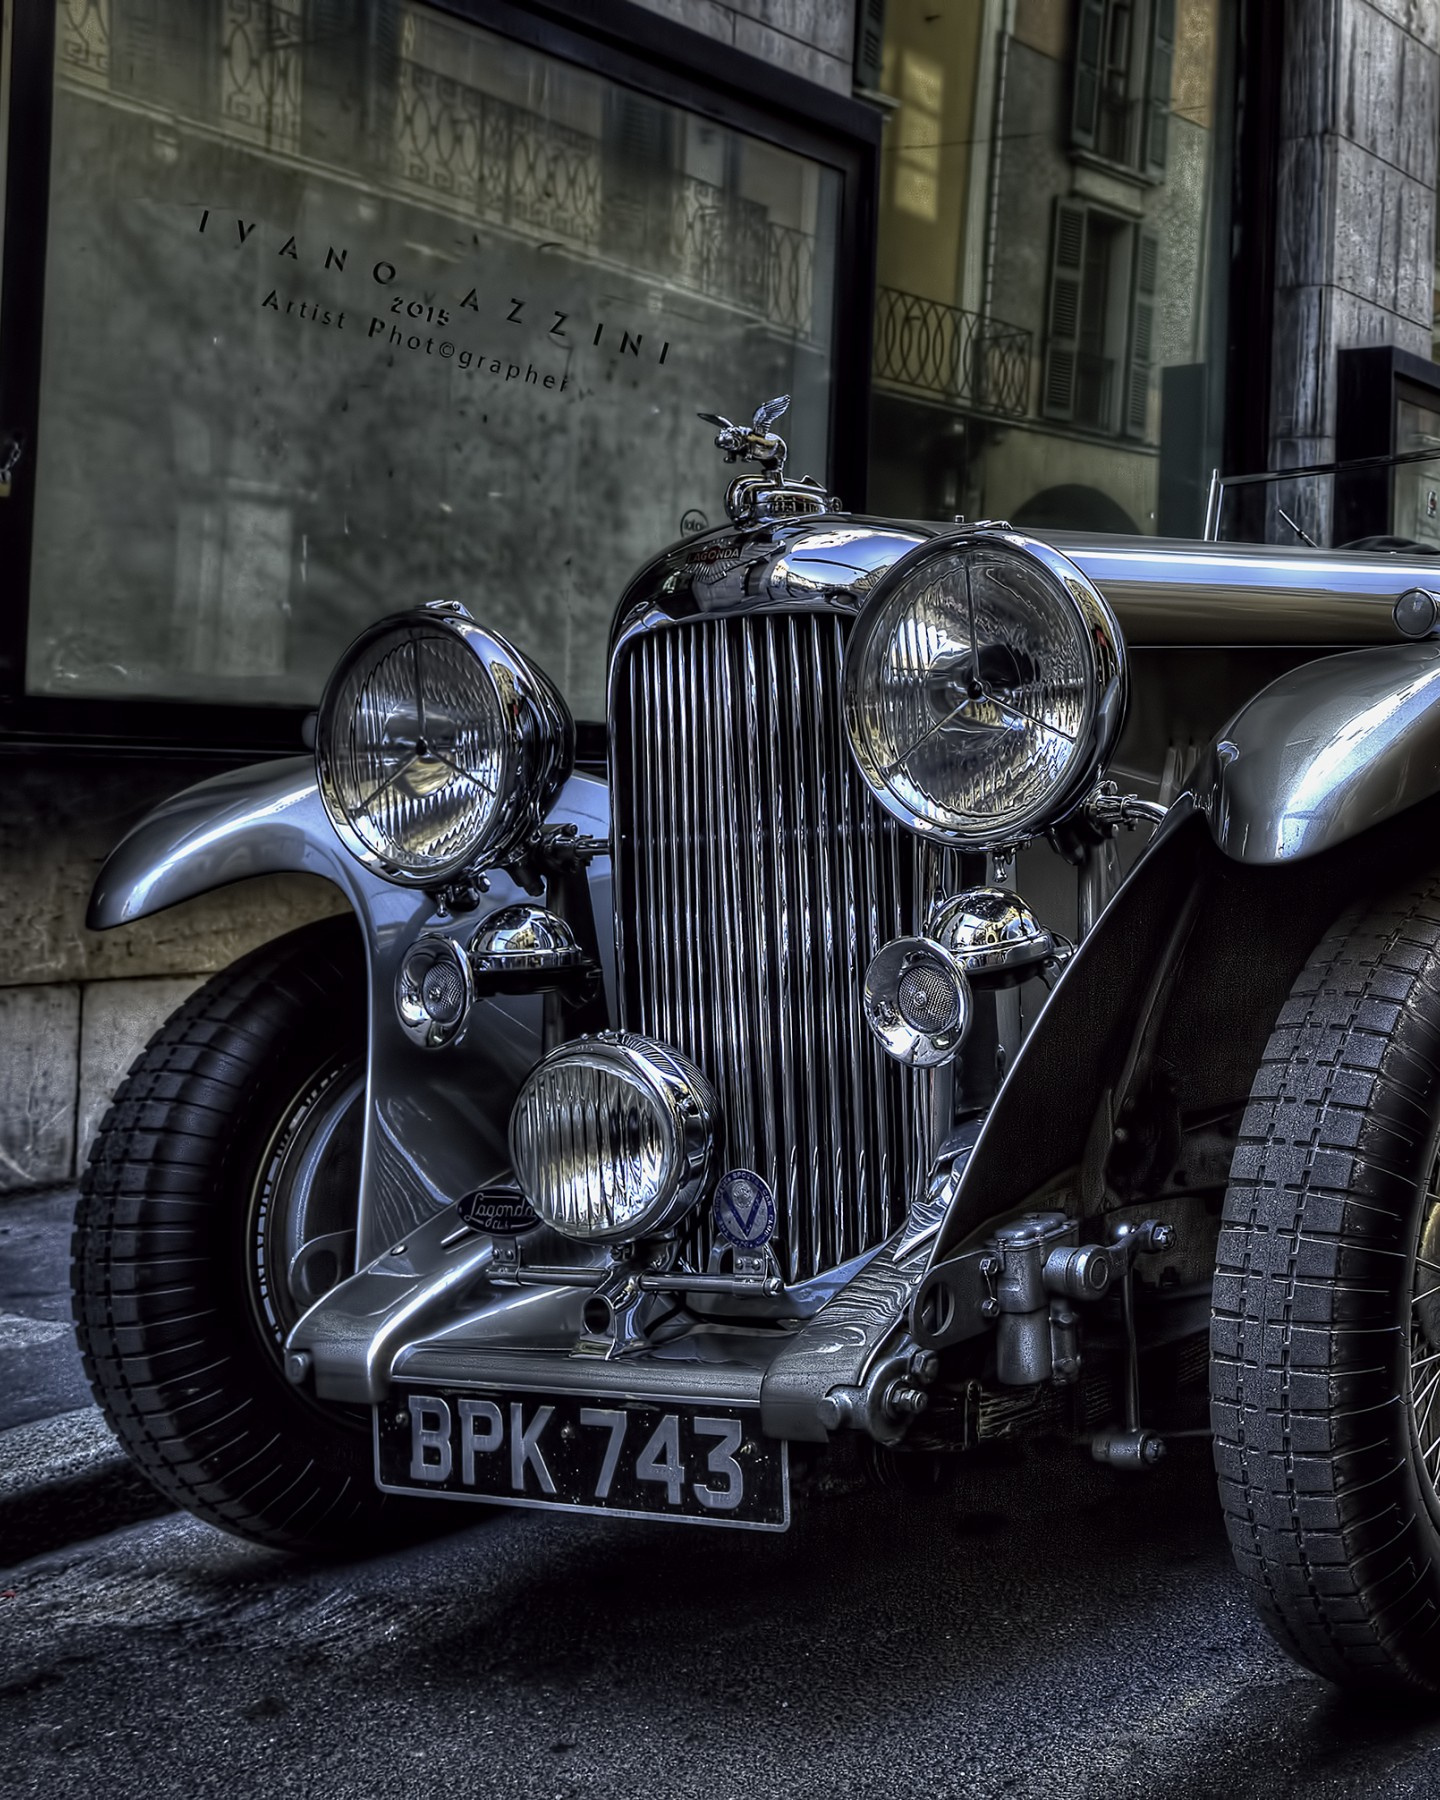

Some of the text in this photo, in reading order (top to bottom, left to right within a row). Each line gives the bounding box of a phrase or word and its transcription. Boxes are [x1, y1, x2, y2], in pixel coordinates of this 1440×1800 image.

[199, 210, 670, 365] IVANO AZZINI
[262, 289, 346, 330] Artist
[390, 296, 450, 327] 2015
[687, 547, 740, 562] LAGONDA
[464, 1192, 535, 1227] Lagonda
[408, 1394, 743, 1510] BPK 743
